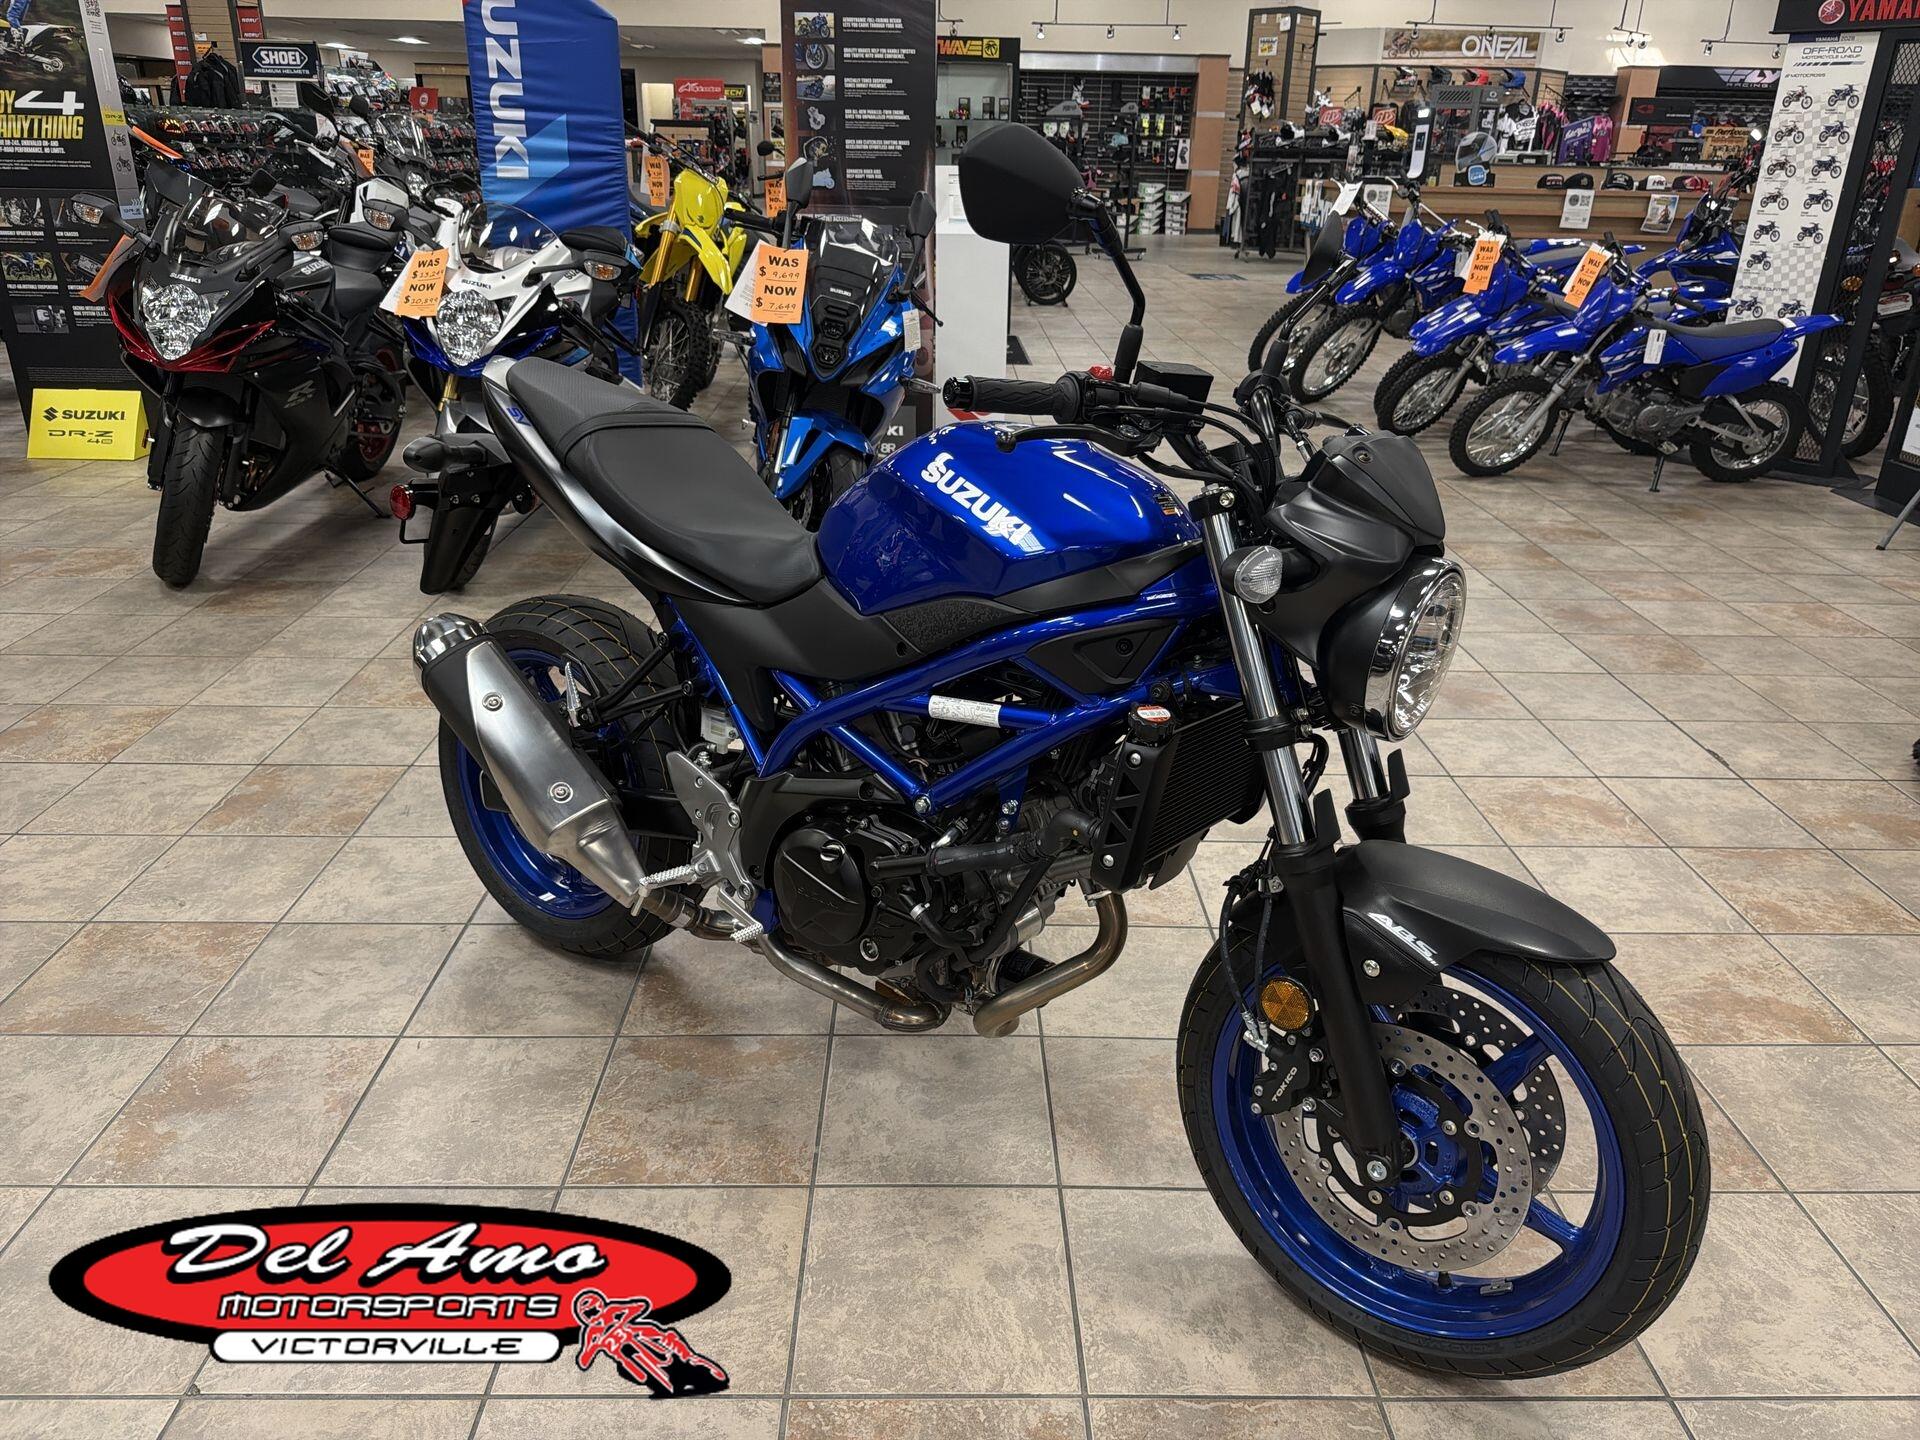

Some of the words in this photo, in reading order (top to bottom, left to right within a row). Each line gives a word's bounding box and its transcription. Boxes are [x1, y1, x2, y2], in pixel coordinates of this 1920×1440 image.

[1850, 0, 1920, 21] YAMA
[1802, 46, 1862, 54] OFF-ROAD
[260, 50, 301, 65] SHOEI
[0, 115, 84, 140] ANYTHING
[418, 258, 440, 268] WAS
[769, 255, 799, 267] WAS
[170, 272, 201, 284] SUZUKI
[461, 278, 492, 290] SUZUKI
[409, 283, 436, 292] NOW
[764, 284, 797, 296] NOW
[62, 410, 125, 421] SUZUKI
[920, 452, 1033, 545] SUZUKI
[1367, 912, 1438, 964] ABS
[1272, 1066, 1298, 1102] TOKICO
